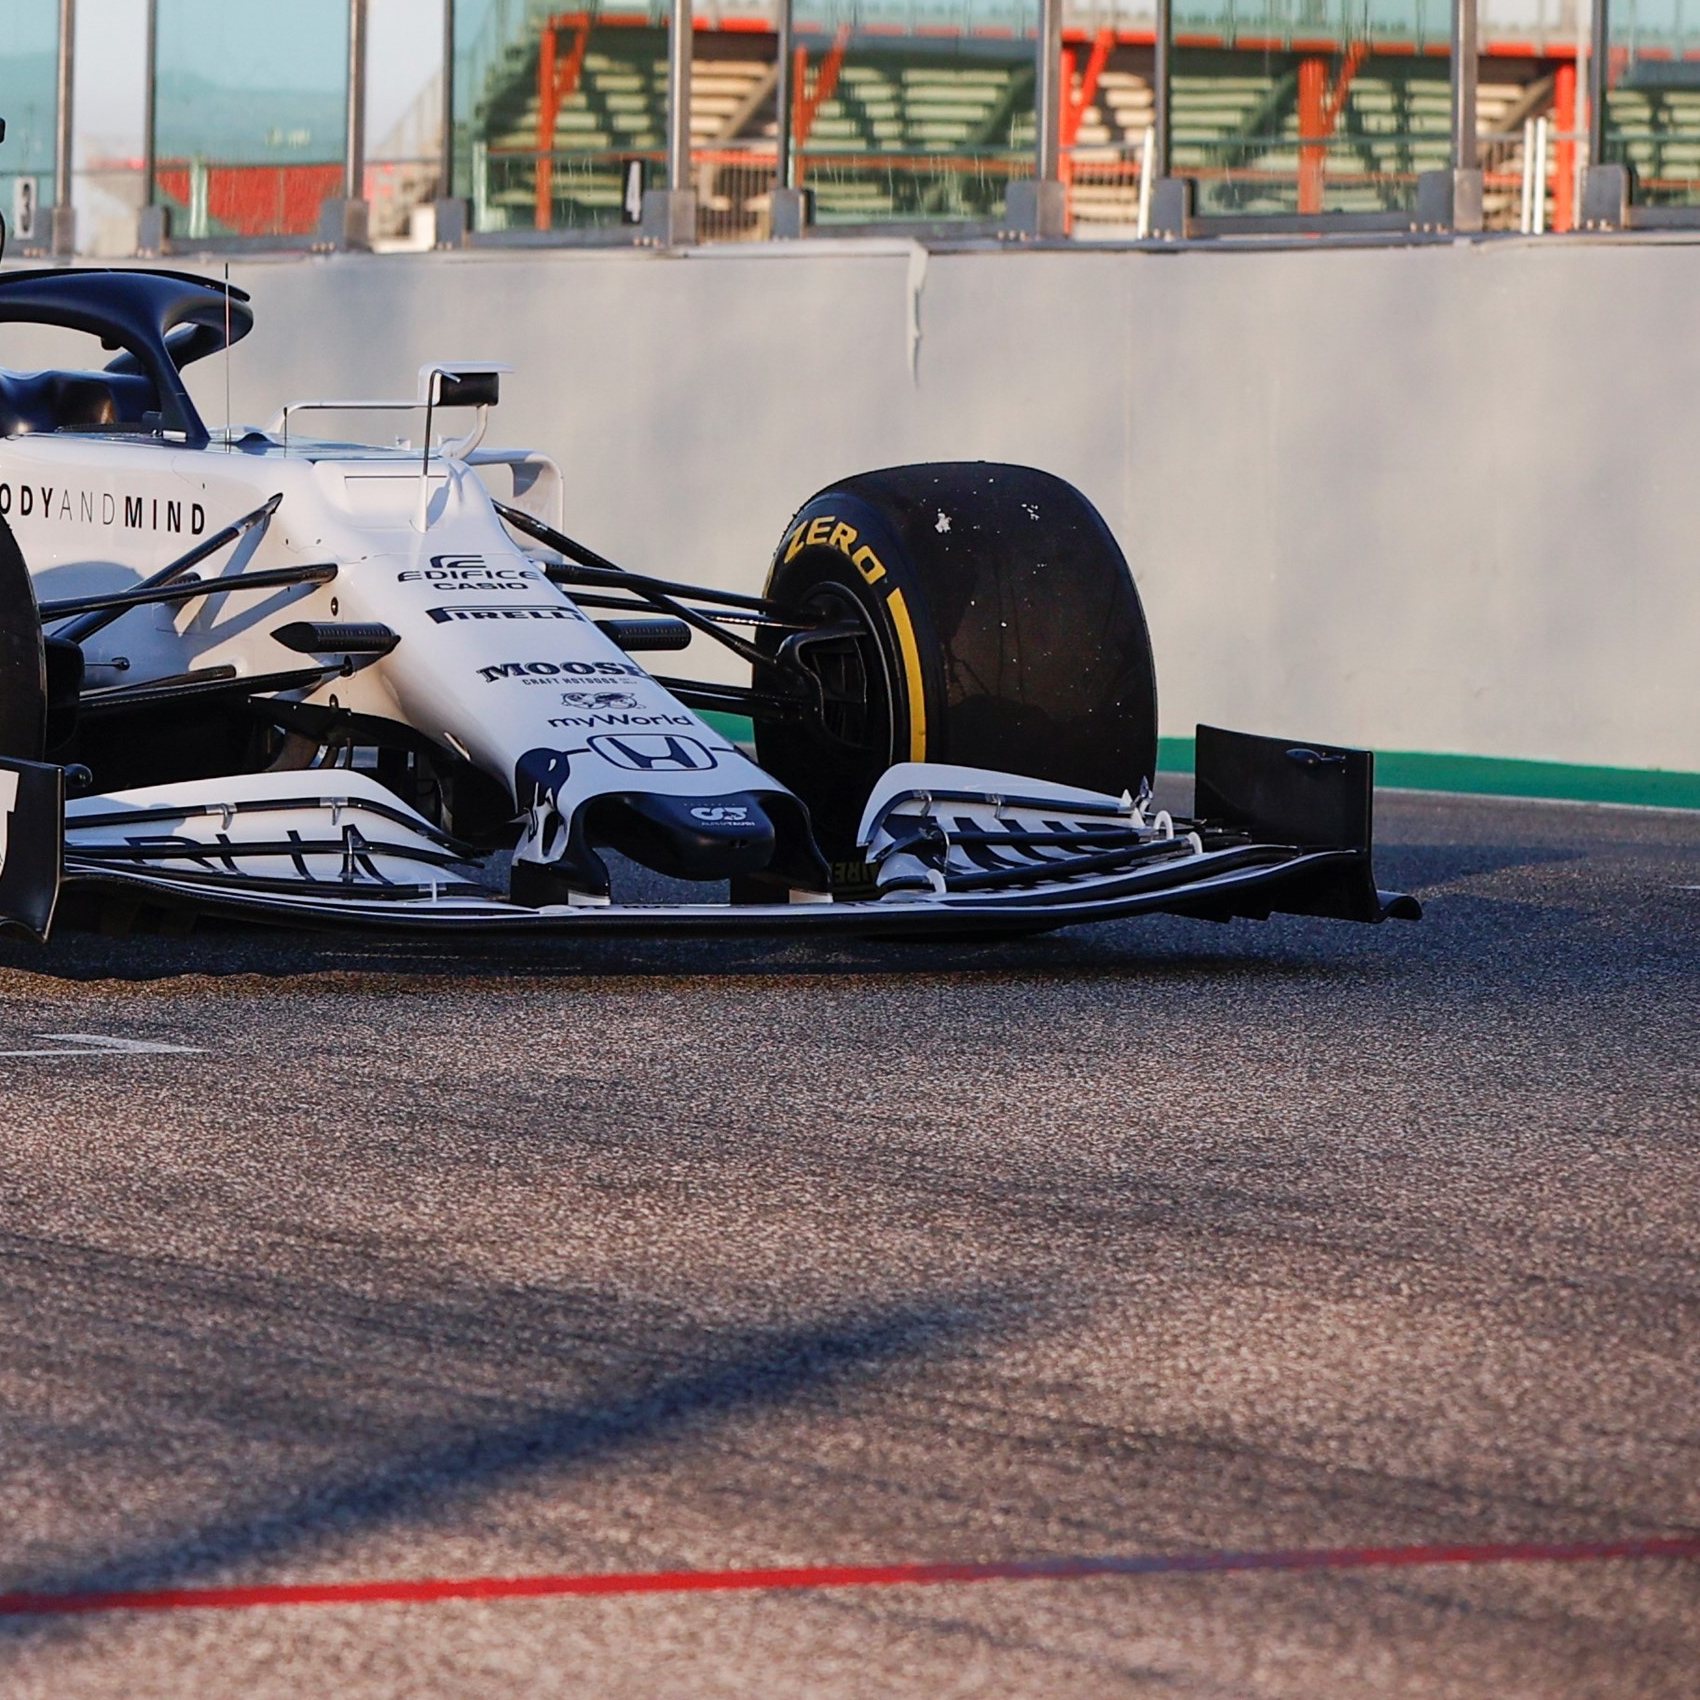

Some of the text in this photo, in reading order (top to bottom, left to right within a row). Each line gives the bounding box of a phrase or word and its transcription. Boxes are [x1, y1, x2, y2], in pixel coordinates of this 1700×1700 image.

[784, 515, 887, 585] ZERO
[397, 570, 542, 582] EDIFICE
[433, 582, 529, 590] CASIO
[425, 605, 587, 624] PIRELLI
[522, 678, 560, 686] CRAFT
[548, 713, 695, 728] myWorld
